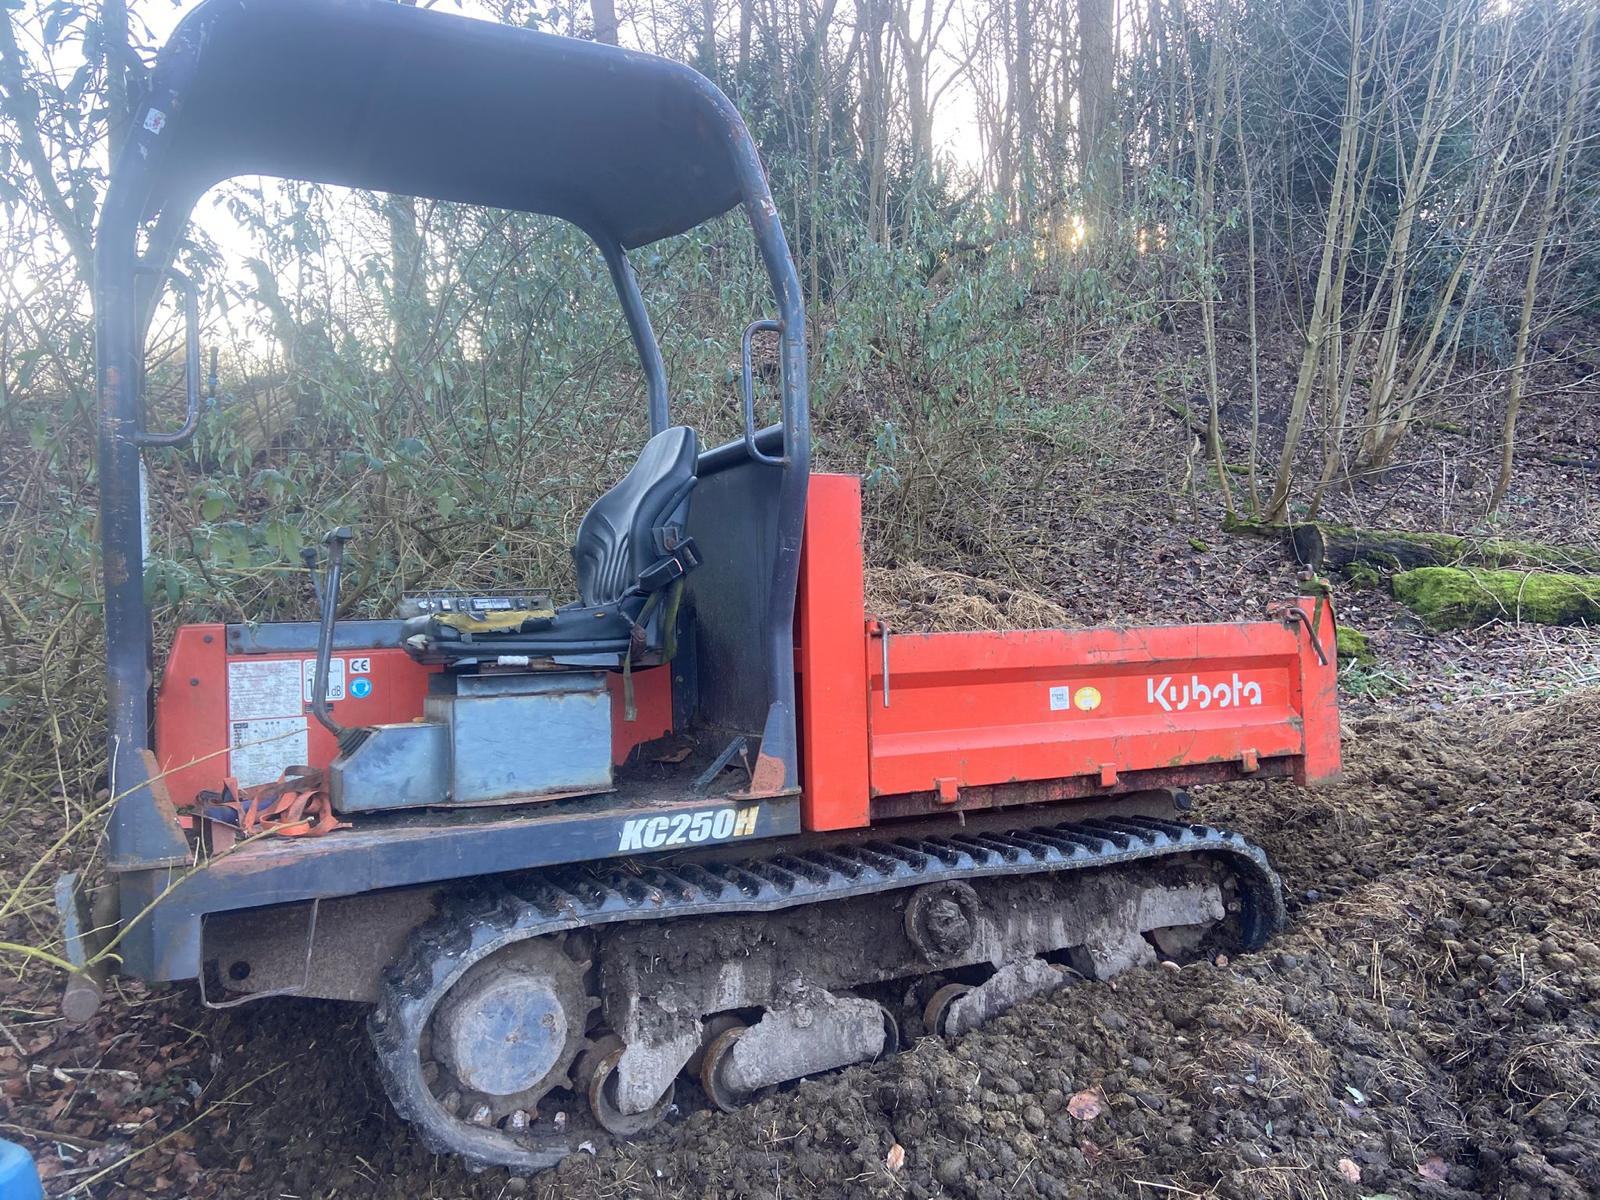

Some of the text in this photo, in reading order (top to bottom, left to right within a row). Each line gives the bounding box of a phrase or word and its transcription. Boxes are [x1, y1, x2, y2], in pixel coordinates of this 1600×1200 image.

[352, 660, 368, 671] CE
[308, 678, 341, 697] 11 dB
[1147, 673, 1262, 711] Kubota
[619, 806, 760, 851] KC250H
